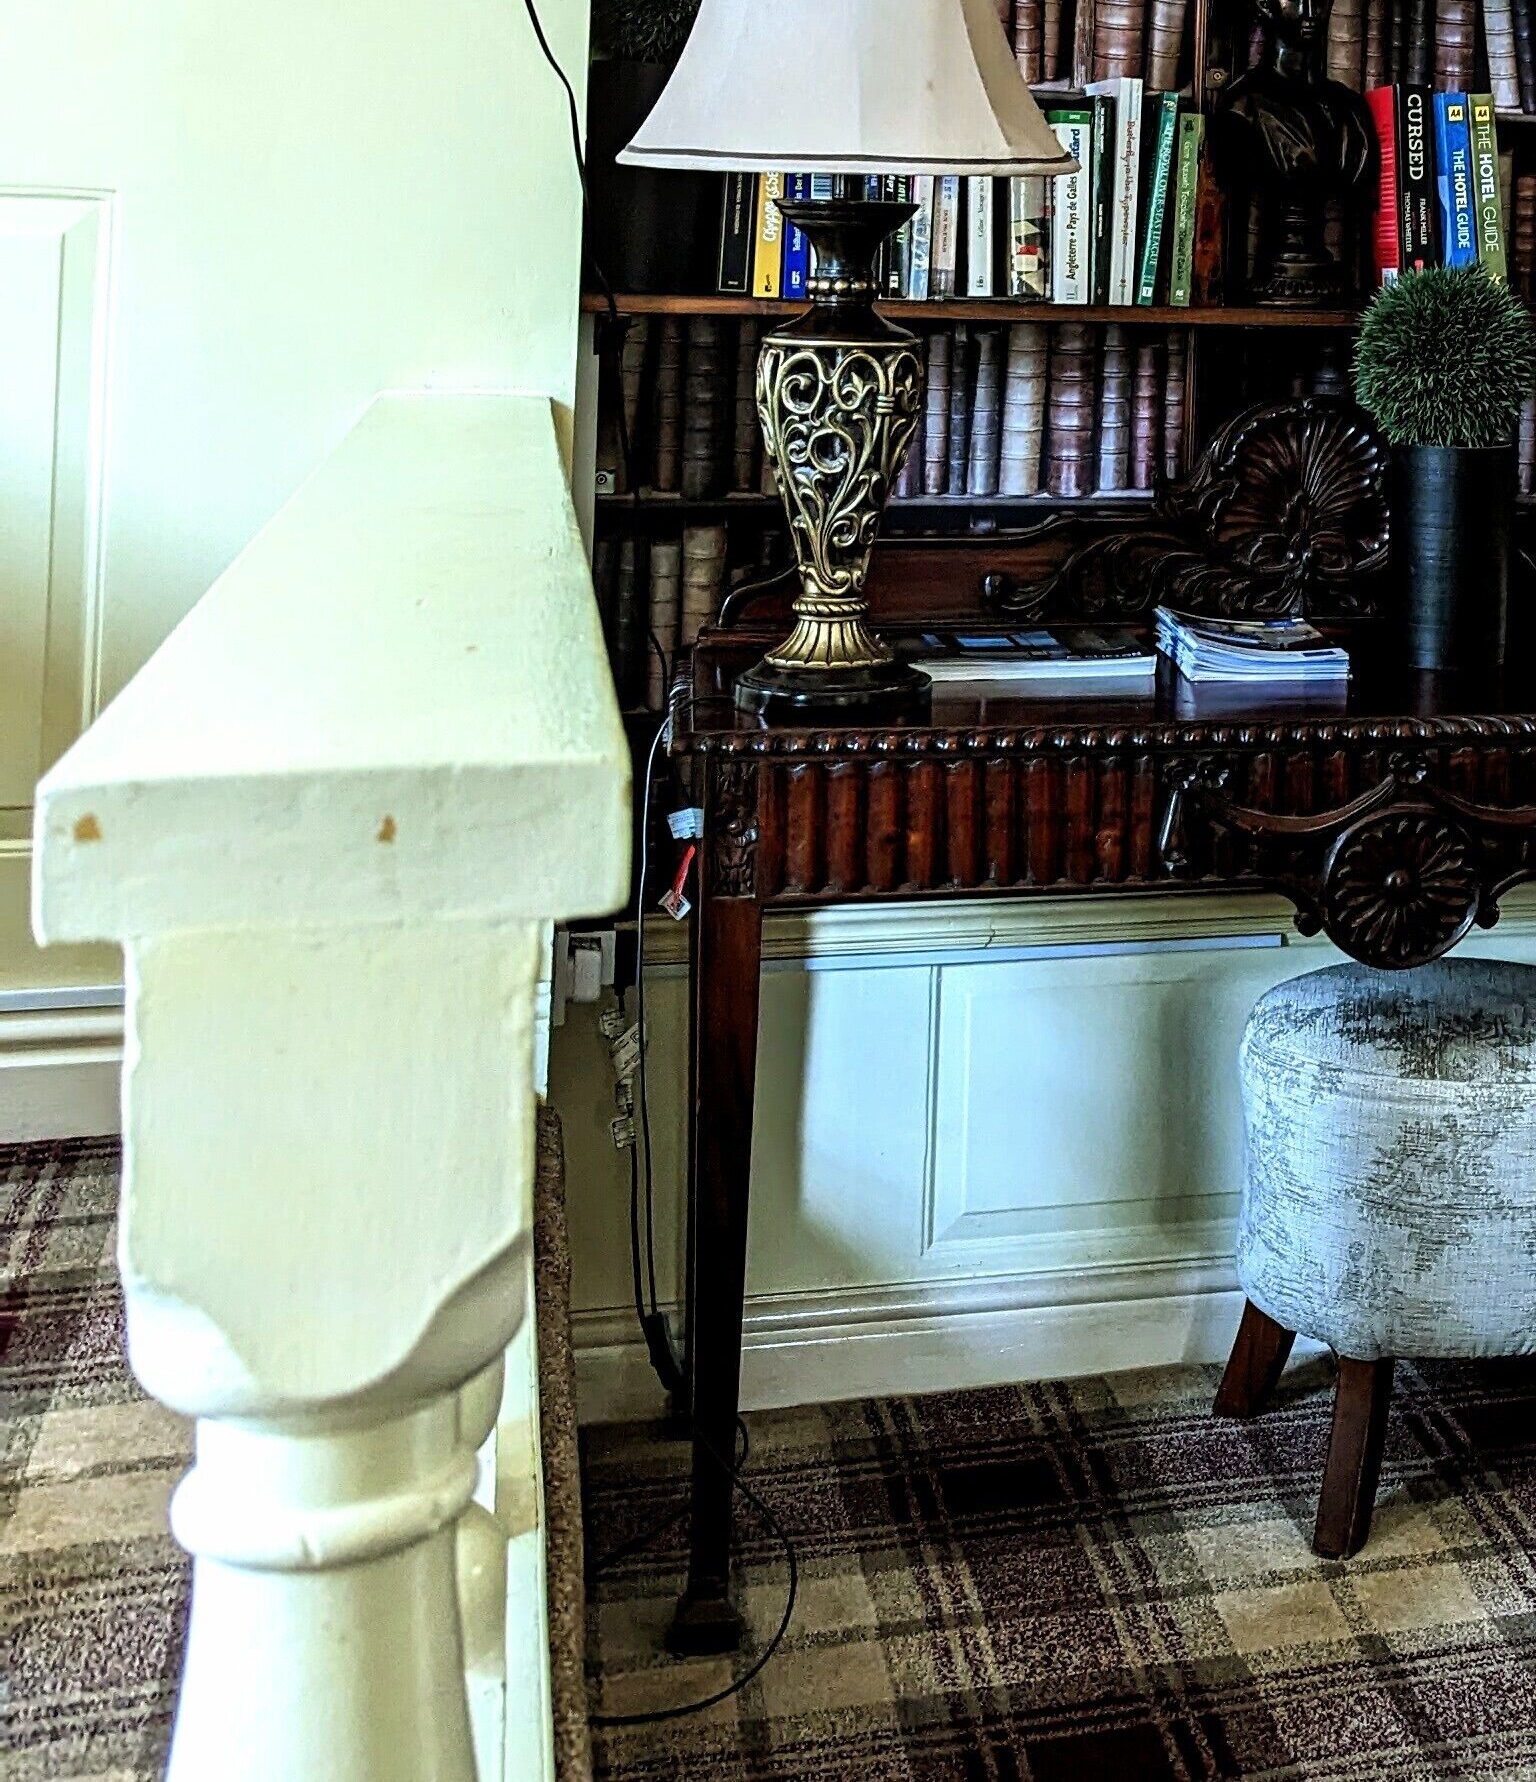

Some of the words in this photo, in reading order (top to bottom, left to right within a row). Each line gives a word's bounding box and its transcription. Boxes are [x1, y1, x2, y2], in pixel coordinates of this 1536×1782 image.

[1450, 109, 1461, 118] AA
[1477, 109, 1488, 118] AA
[1120, 121, 1135, 161] Butterfly
[1407, 94, 1424, 181] CURSED
[1477, 123, 1491, 149] THE
[1125, 163, 1135, 175] in
[1159, 146, 1172, 177] ROYAL
[1453, 150, 1465, 172] THE
[1067, 176, 1078, 199] Galles
[1125, 176, 1134, 193] the
[1454, 173, 1468, 212] HOTEL
[1479, 154, 1495, 203] HOTEL
[1067, 201, 1077, 213] de
[1153, 180, 1168, 229] OVER-SEAS
[1403, 191, 1412, 221] THOMAS
[1419, 198, 1427, 221] FRANK
[1066, 214, 1077, 231] Pays
[1420, 222, 1428, 245] MILLER
[1457, 213, 1470, 249] GUIDE
[1483, 206, 1500, 252] GUIDE
[1065, 240, 1077, 280] Angleterre
[1148, 231, 1162, 266] LEAGUE
